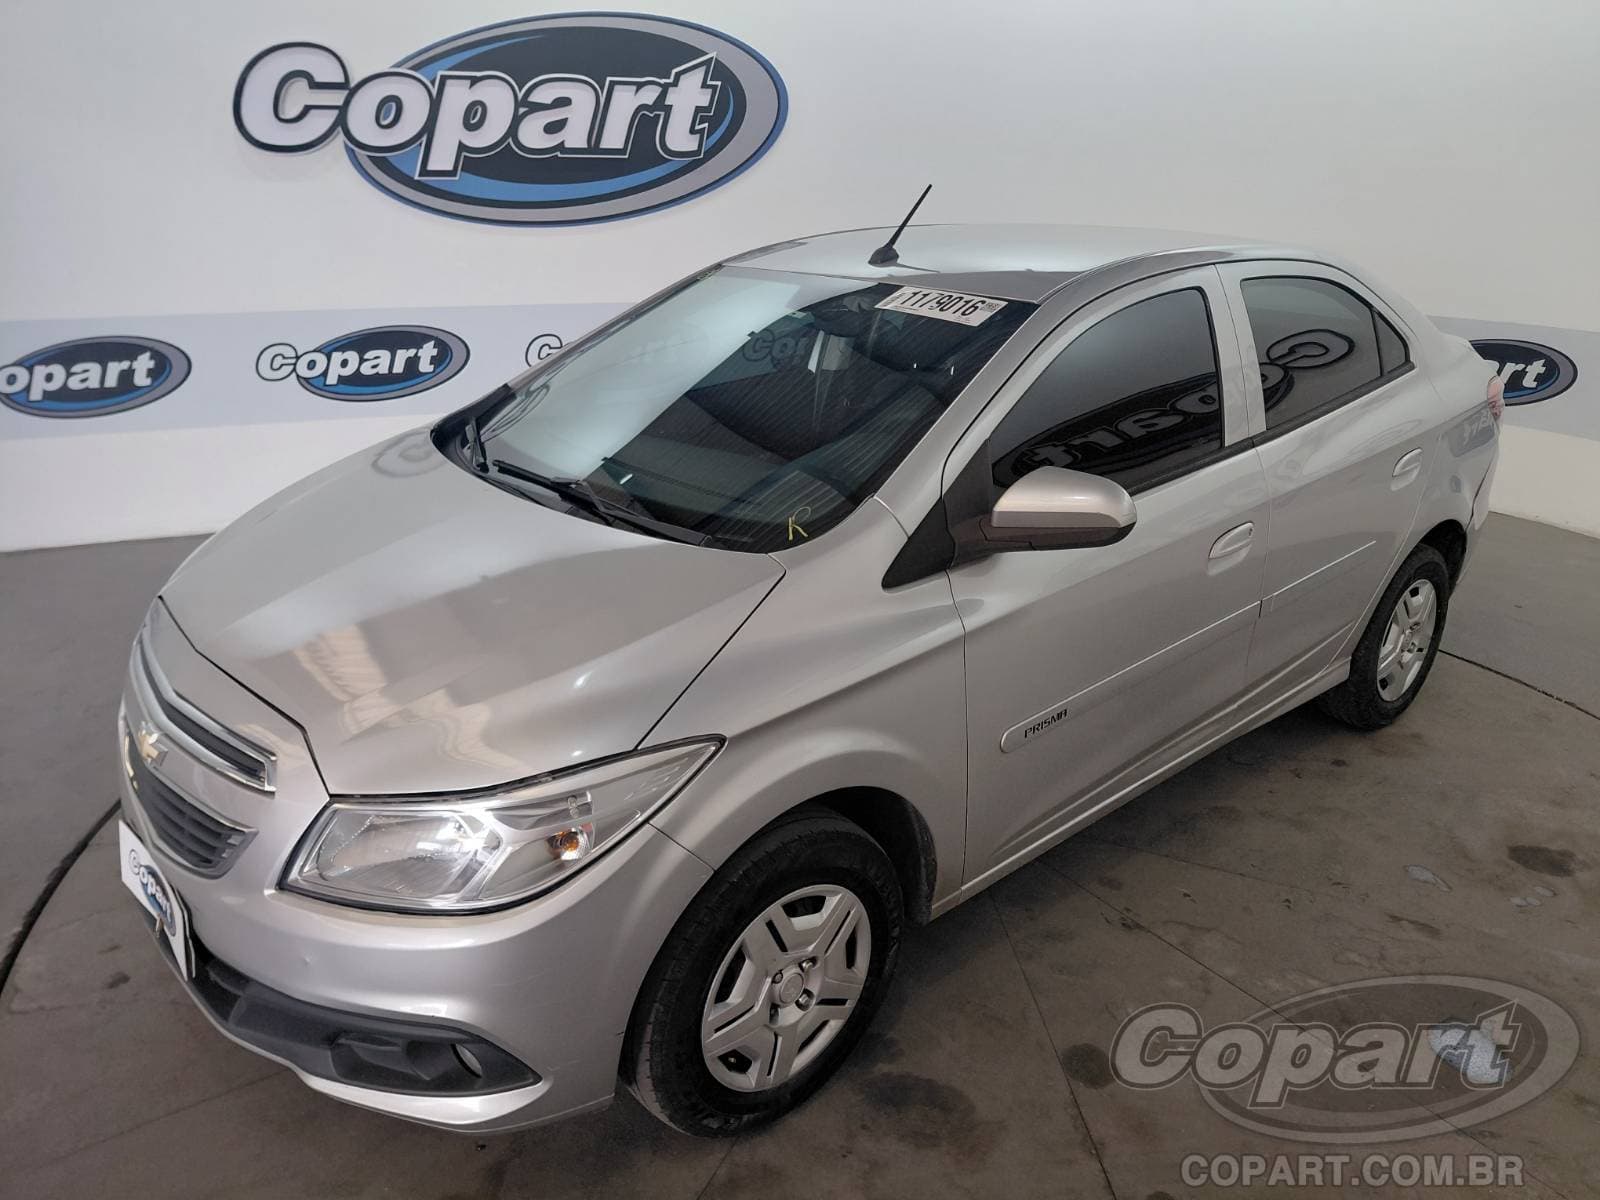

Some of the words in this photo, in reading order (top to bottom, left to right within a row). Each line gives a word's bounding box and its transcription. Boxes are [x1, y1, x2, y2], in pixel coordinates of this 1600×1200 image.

[234, 42, 721, 179] Copart
[900, 290, 986, 317] 1179016
[0, 351, 155, 402] opart
[256, 342, 438, 386] Copart
[1024, 708, 1068, 738] PRISMA
[129, 849, 172, 923] Copart
